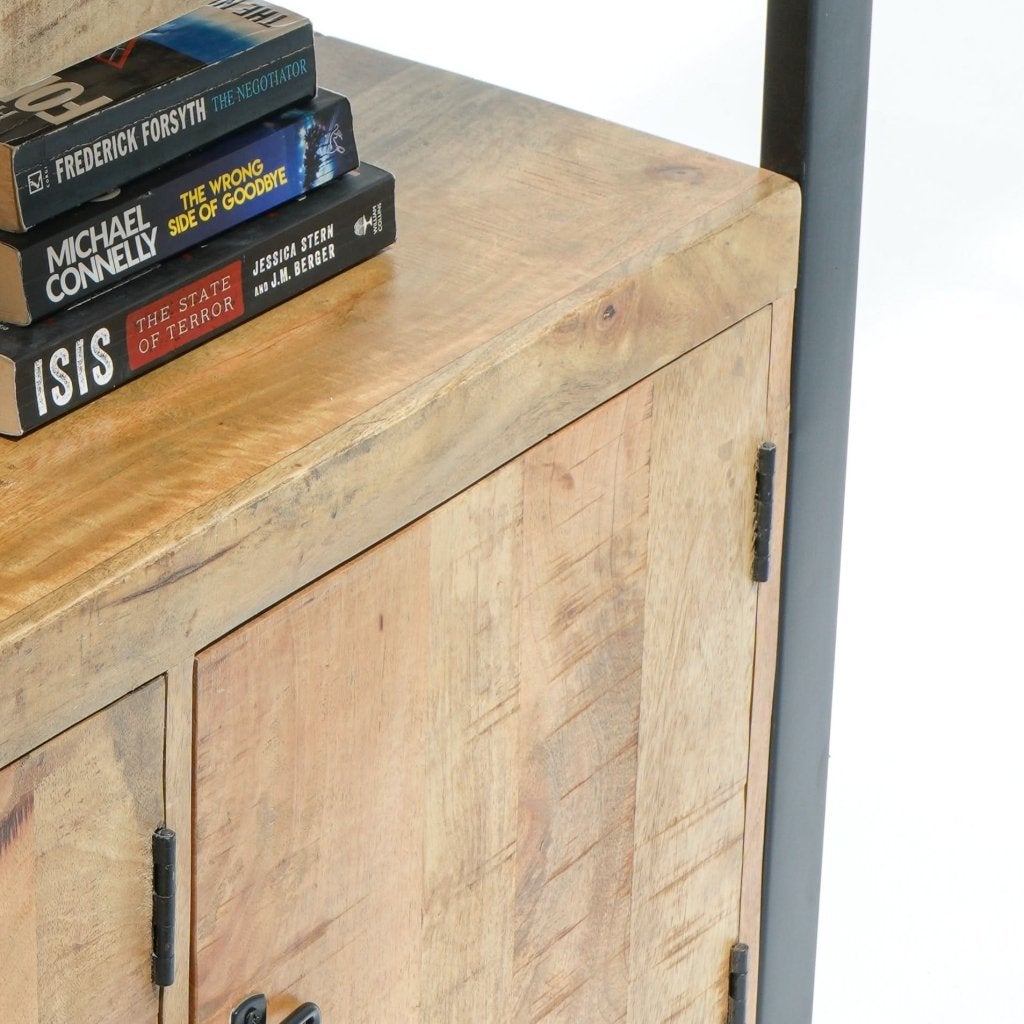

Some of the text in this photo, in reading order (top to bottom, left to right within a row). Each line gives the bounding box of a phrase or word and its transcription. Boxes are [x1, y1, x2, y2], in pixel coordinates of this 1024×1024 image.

[232, 4, 288, 28] THE
[211, 58, 307, 113] THE NEGOTIATOR
[55, 97, 207, 184] FREDERICK FORSYTH
[168, 166, 288, 237] SIDE OF GOODBYE
[180, 158, 264, 211] THE WRONG
[46, 205, 151, 273] MICHAEL
[46, 227, 159, 303] CONNELLY
[252, 223, 335, 276] JESSICA STERN
[254, 245, 336, 296] AND J.M. BERGER
[136, 276, 232, 334] THE STATE
[138, 296, 234, 355] OF TERROR
[34, 327, 114, 416] ISIS
